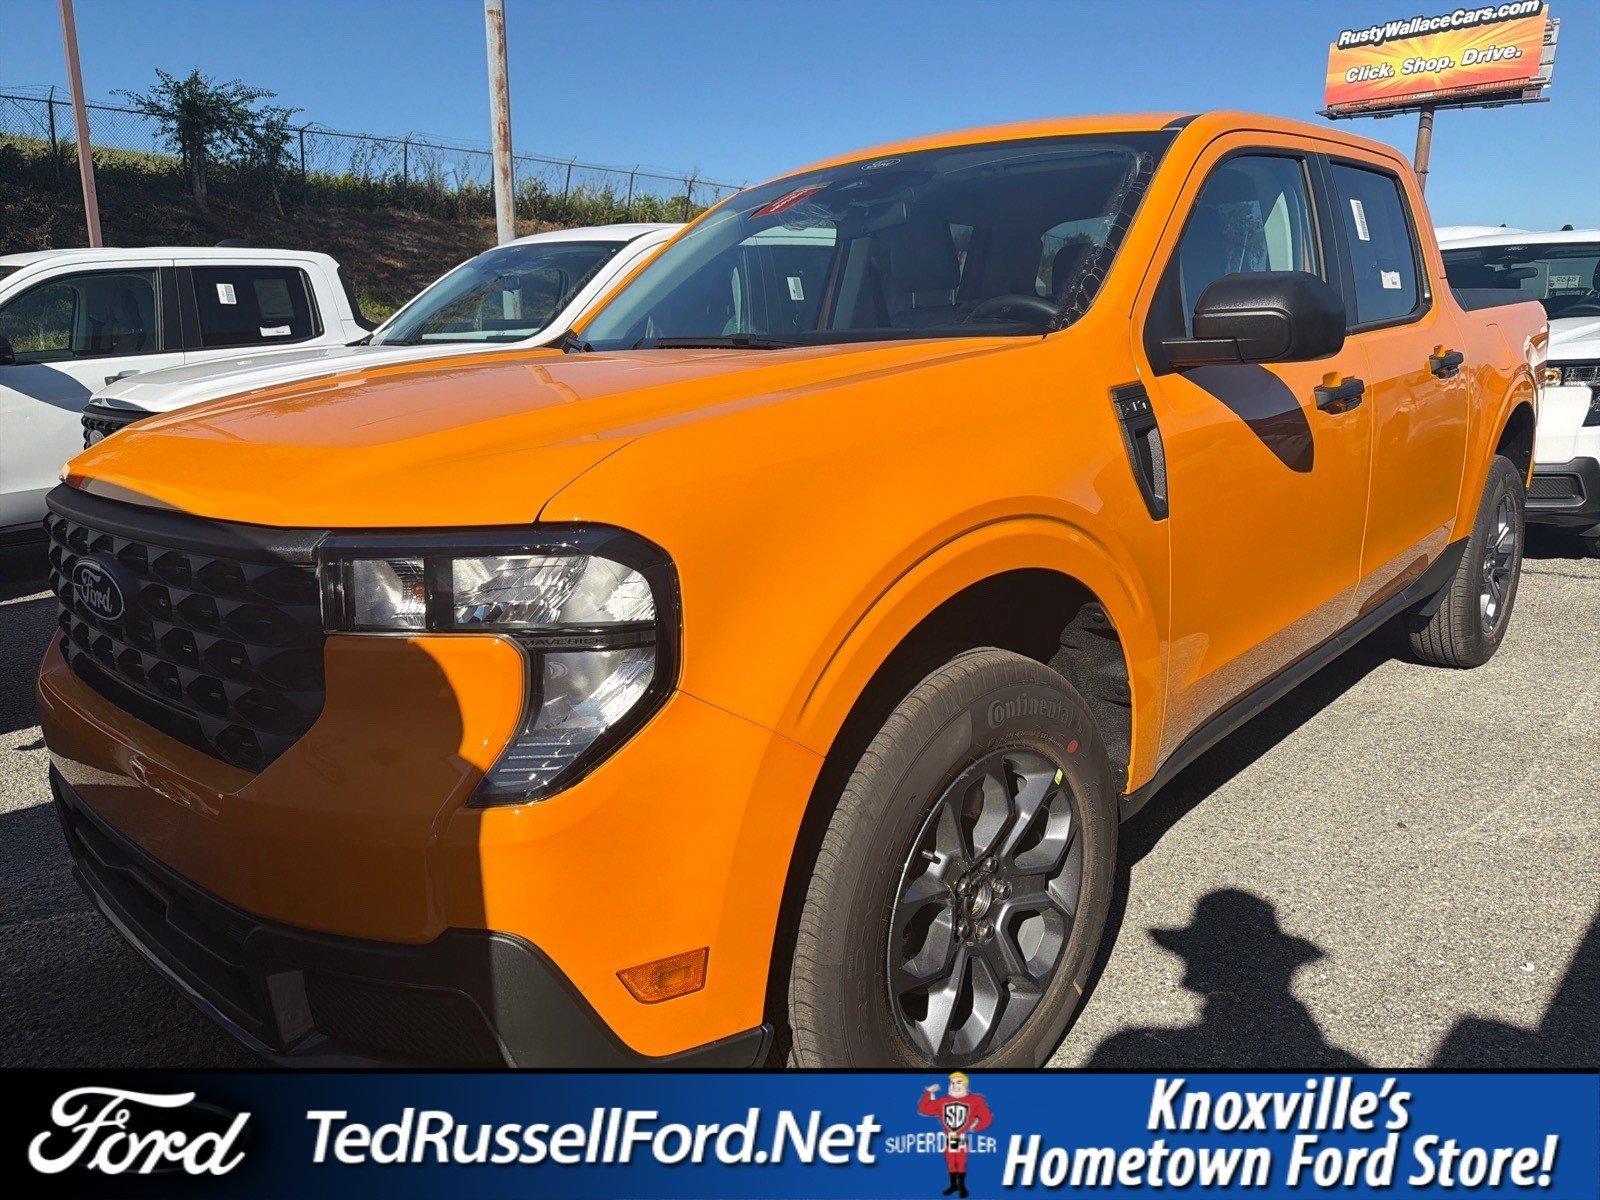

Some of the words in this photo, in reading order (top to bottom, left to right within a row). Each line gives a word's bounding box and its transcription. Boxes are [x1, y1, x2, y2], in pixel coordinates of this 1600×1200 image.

[1337, 0, 1539, 47] RustyWallaceCars.com
[1345, 63, 1396, 83] Click.
[1401, 56, 1455, 74] Shop.
[1461, 45, 1522, 66] Drive.
[81, 568, 113, 613] Ford
[522, 637, 605, 646] MAVERICK
[988, 692, 1075, 729] Continental
